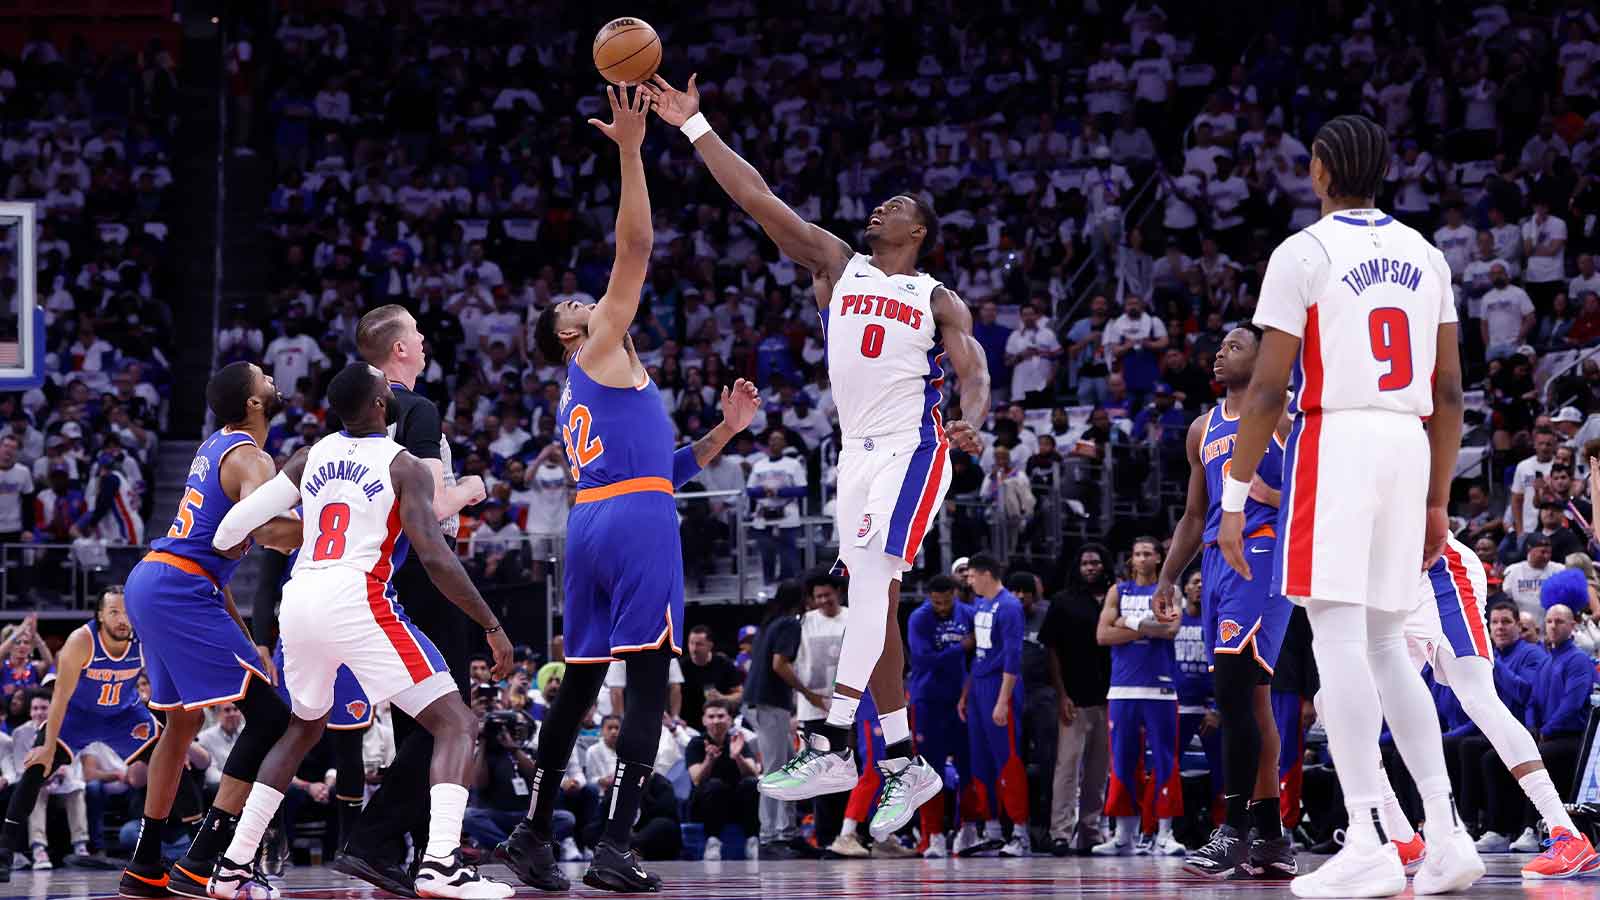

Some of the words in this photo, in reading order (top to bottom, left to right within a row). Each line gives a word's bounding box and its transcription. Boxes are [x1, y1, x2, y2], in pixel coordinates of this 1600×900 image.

[1341, 258, 1422, 296] THOMPSON
[840, 294, 924, 330] PISTONS
[860, 323, 886, 359] 0
[1368, 307, 1413, 392] 9
[562, 404, 604, 482] 32
[1204, 437, 1230, 465] NEW
[305, 460, 370, 498] HARDAWAY
[363, 481, 385, 502] JR.
[167, 486, 204, 538] 5
[313, 502, 350, 562] 8
[86, 668, 112, 682] NEW
[97, 682, 123, 705] 11
